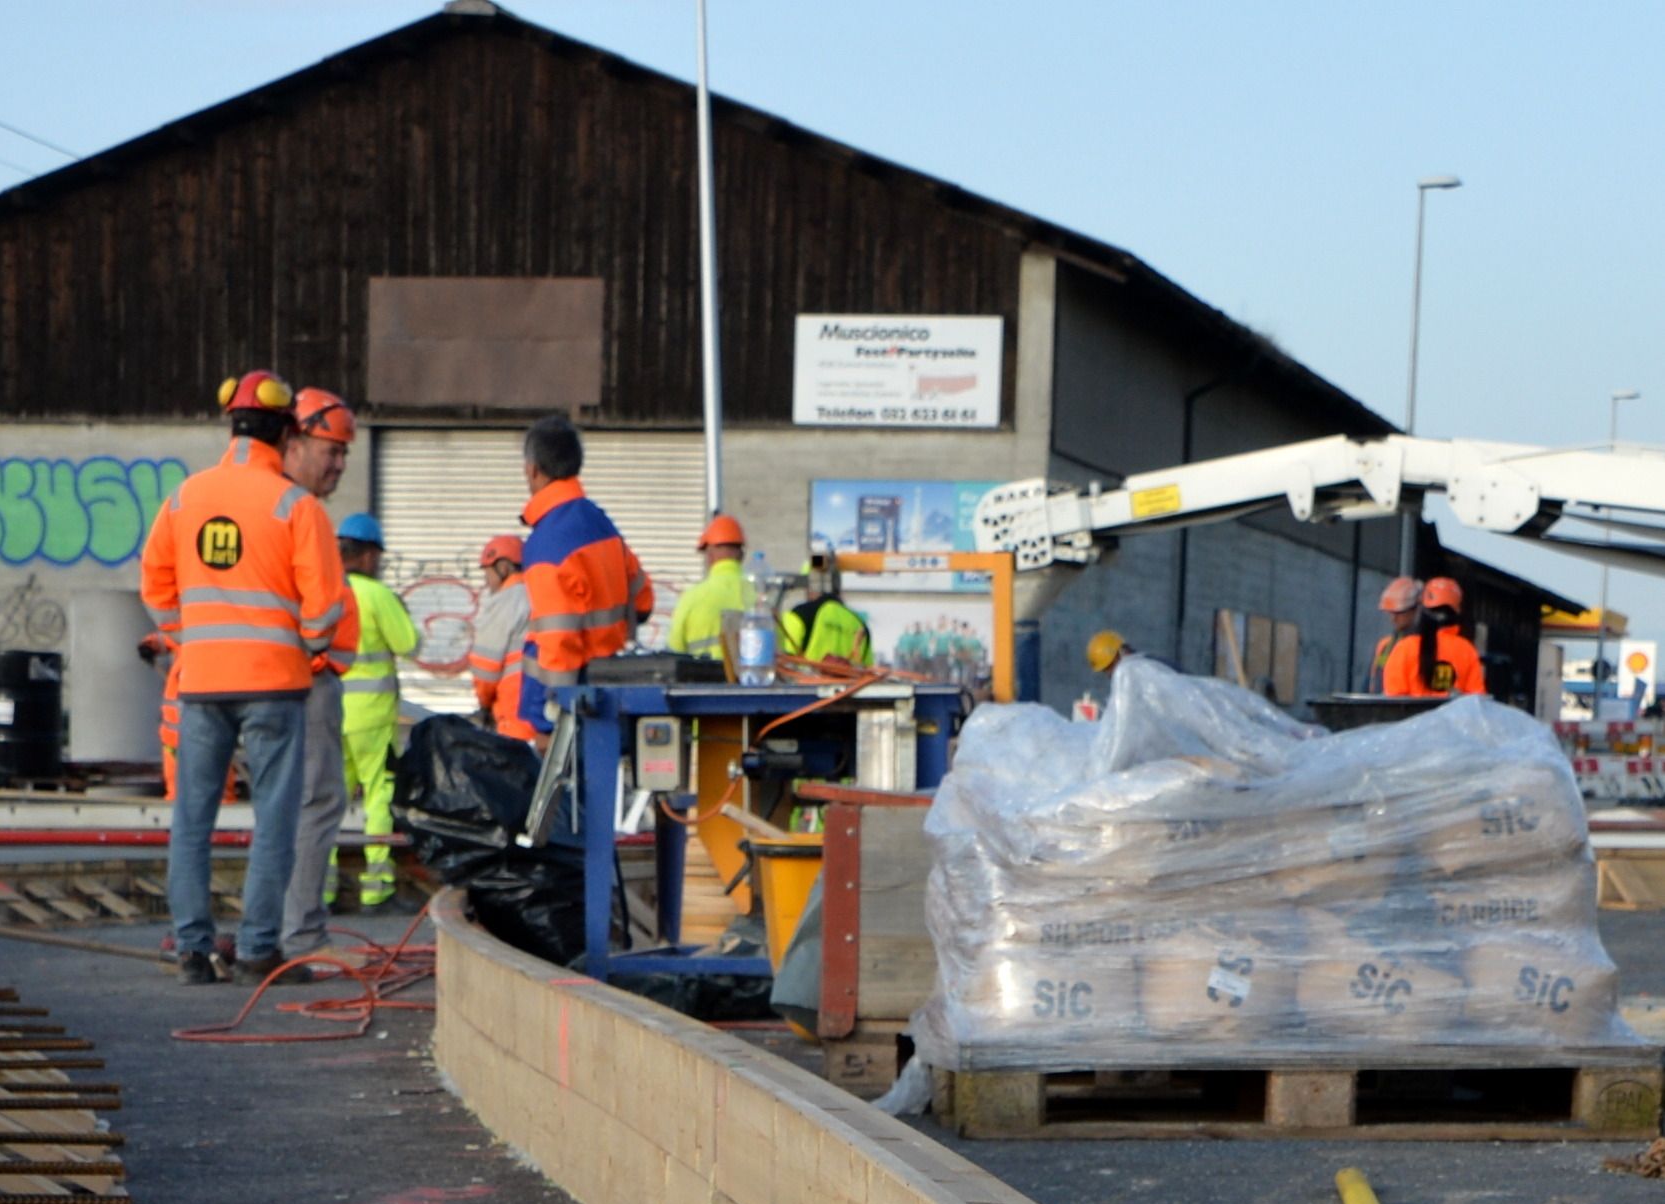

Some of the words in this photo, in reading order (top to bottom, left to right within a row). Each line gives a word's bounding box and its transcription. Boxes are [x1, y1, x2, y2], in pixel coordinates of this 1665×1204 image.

[819, 323, 930, 342] Muscionico
[1440, 897, 1539, 926] CARBIDE
[1032, 979, 1093, 1018] SiC
[1350, 962, 1412, 1014] SiC
[1514, 965, 1575, 1014] SiC
